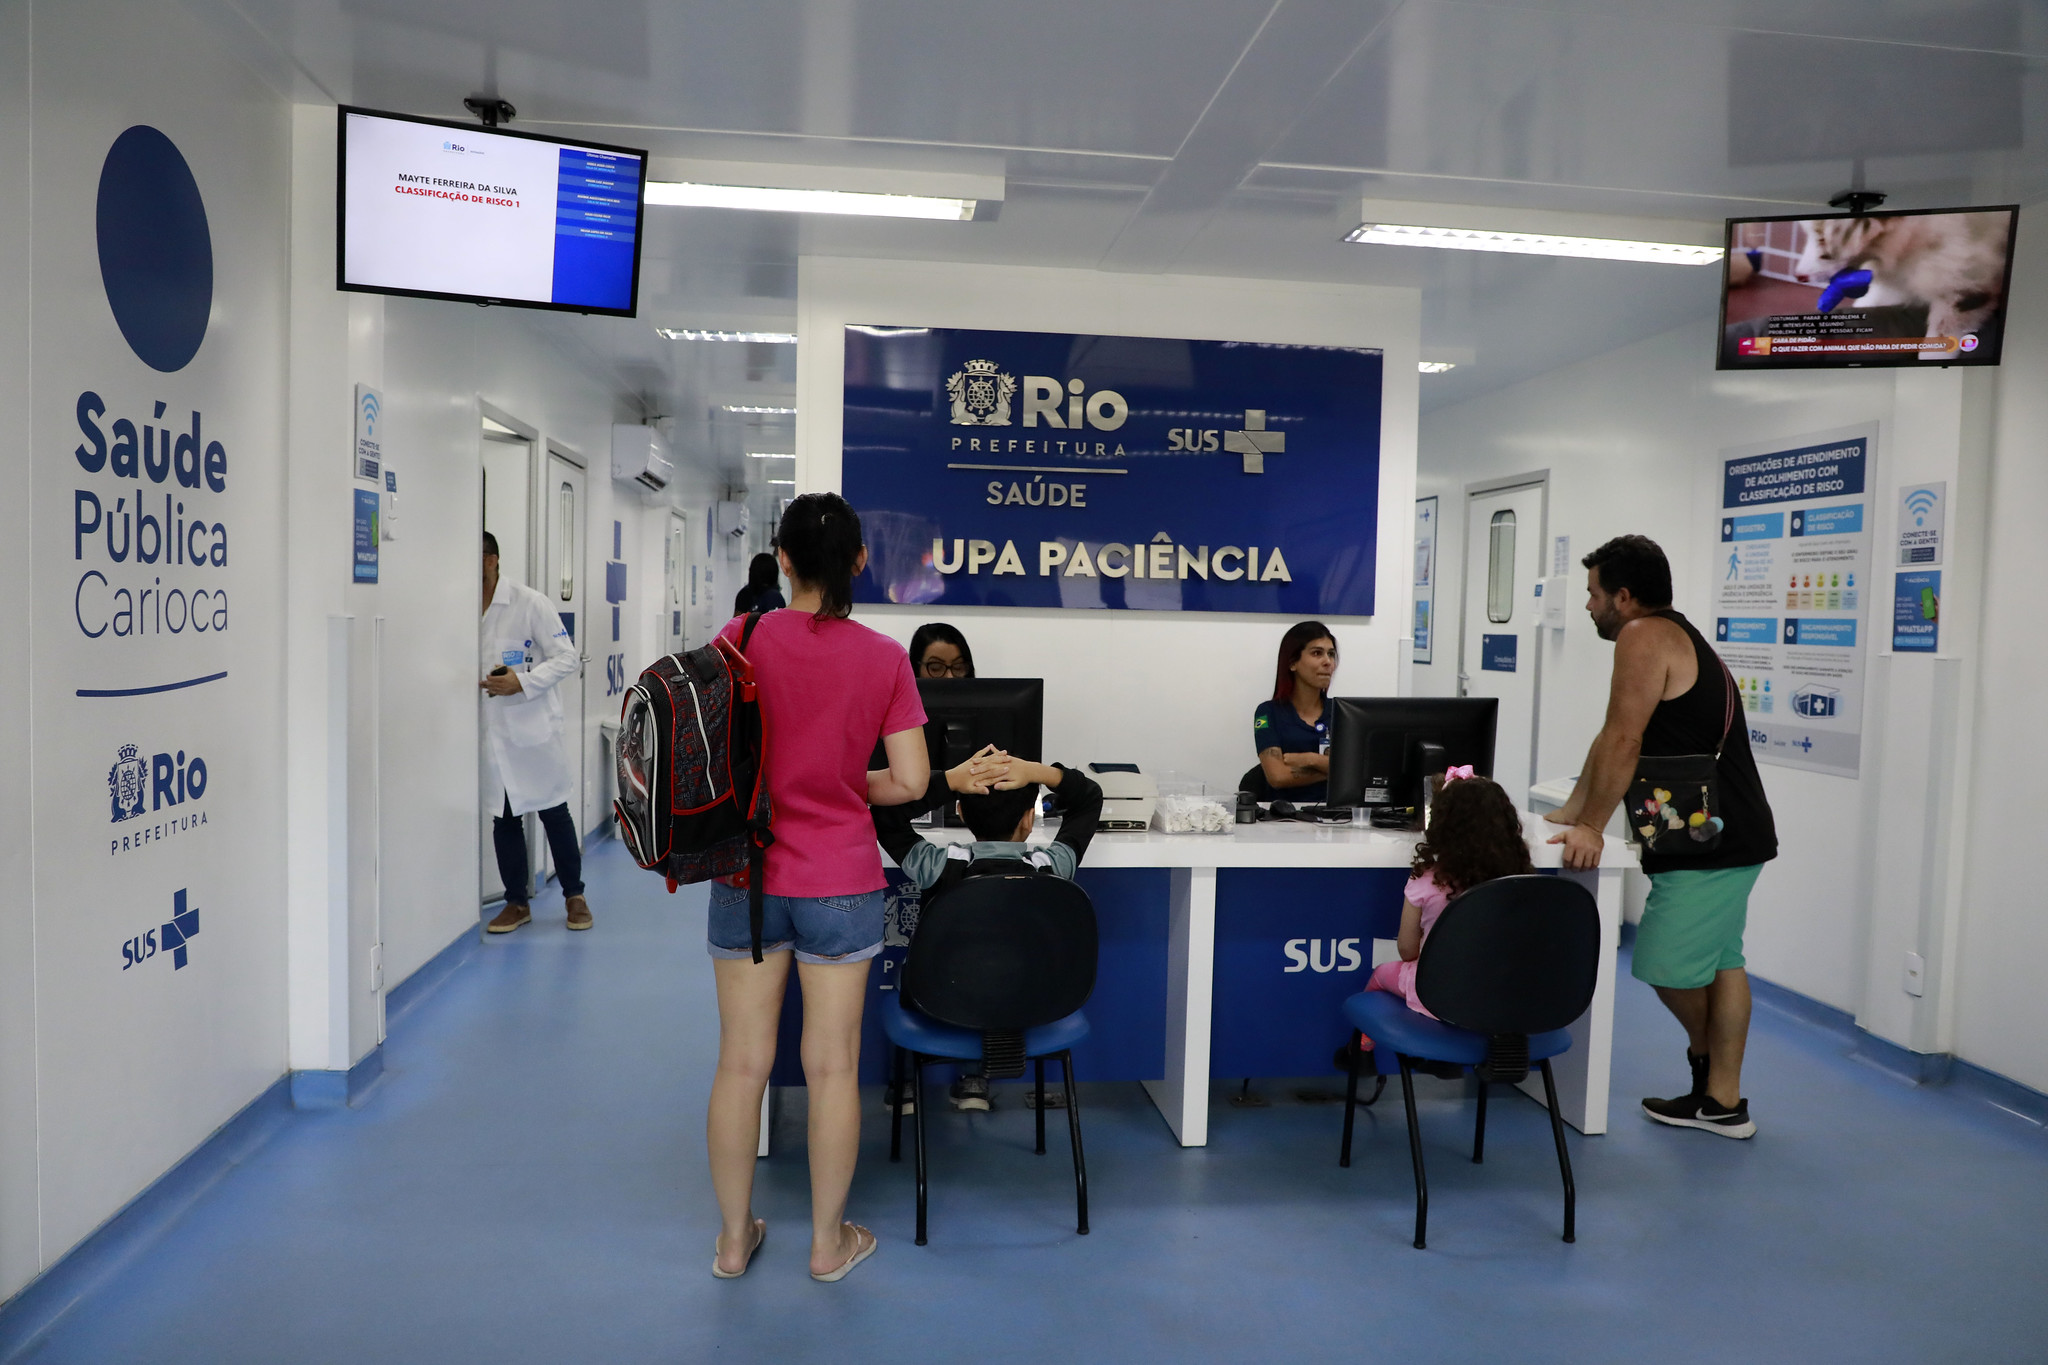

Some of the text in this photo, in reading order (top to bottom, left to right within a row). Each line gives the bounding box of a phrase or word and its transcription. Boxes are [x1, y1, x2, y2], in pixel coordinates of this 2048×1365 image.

[451, 144, 465, 152] Rio
[395, 185, 469, 202] CLASSIFICAÇÃO
[471, 195, 483, 203] DE
[486, 197, 513, 207] RISCO
[398, 173, 517, 195] MAYTE FERREIRA DA SILVA
[1861, 342, 1875, 350] NÃO
[1023, 375, 1129, 432] Rio
[74, 390, 228, 494] Saúde
[951, 437, 1126, 456] PREFEITURA
[1168, 428, 1219, 452] SUS
[1728, 446, 1861, 476] ORIENTAÇÕES DE ATENDIMENTO
[1745, 465, 1839, 488] DE ACOLHIMENTO COM
[986, 475, 1087, 508] SAÚDE
[1739, 479, 1844, 502] CLASSIFICAÇÃO DE RISCO
[74, 489, 228, 568] Pública
[1902, 530, 1937, 539] CONECTE-SE
[932, 531, 1293, 582] UPA PACIÊNCIA
[75, 569, 228, 638] Carioca
[606, 653, 624, 697] SUS
[1751, 729, 1767, 744] Rio
[152, 749, 208, 812] Rio
[111, 811, 208, 856] PREFEITURA
[121, 928, 157, 971] SUS
[1283, 937, 1362, 973] SUS
